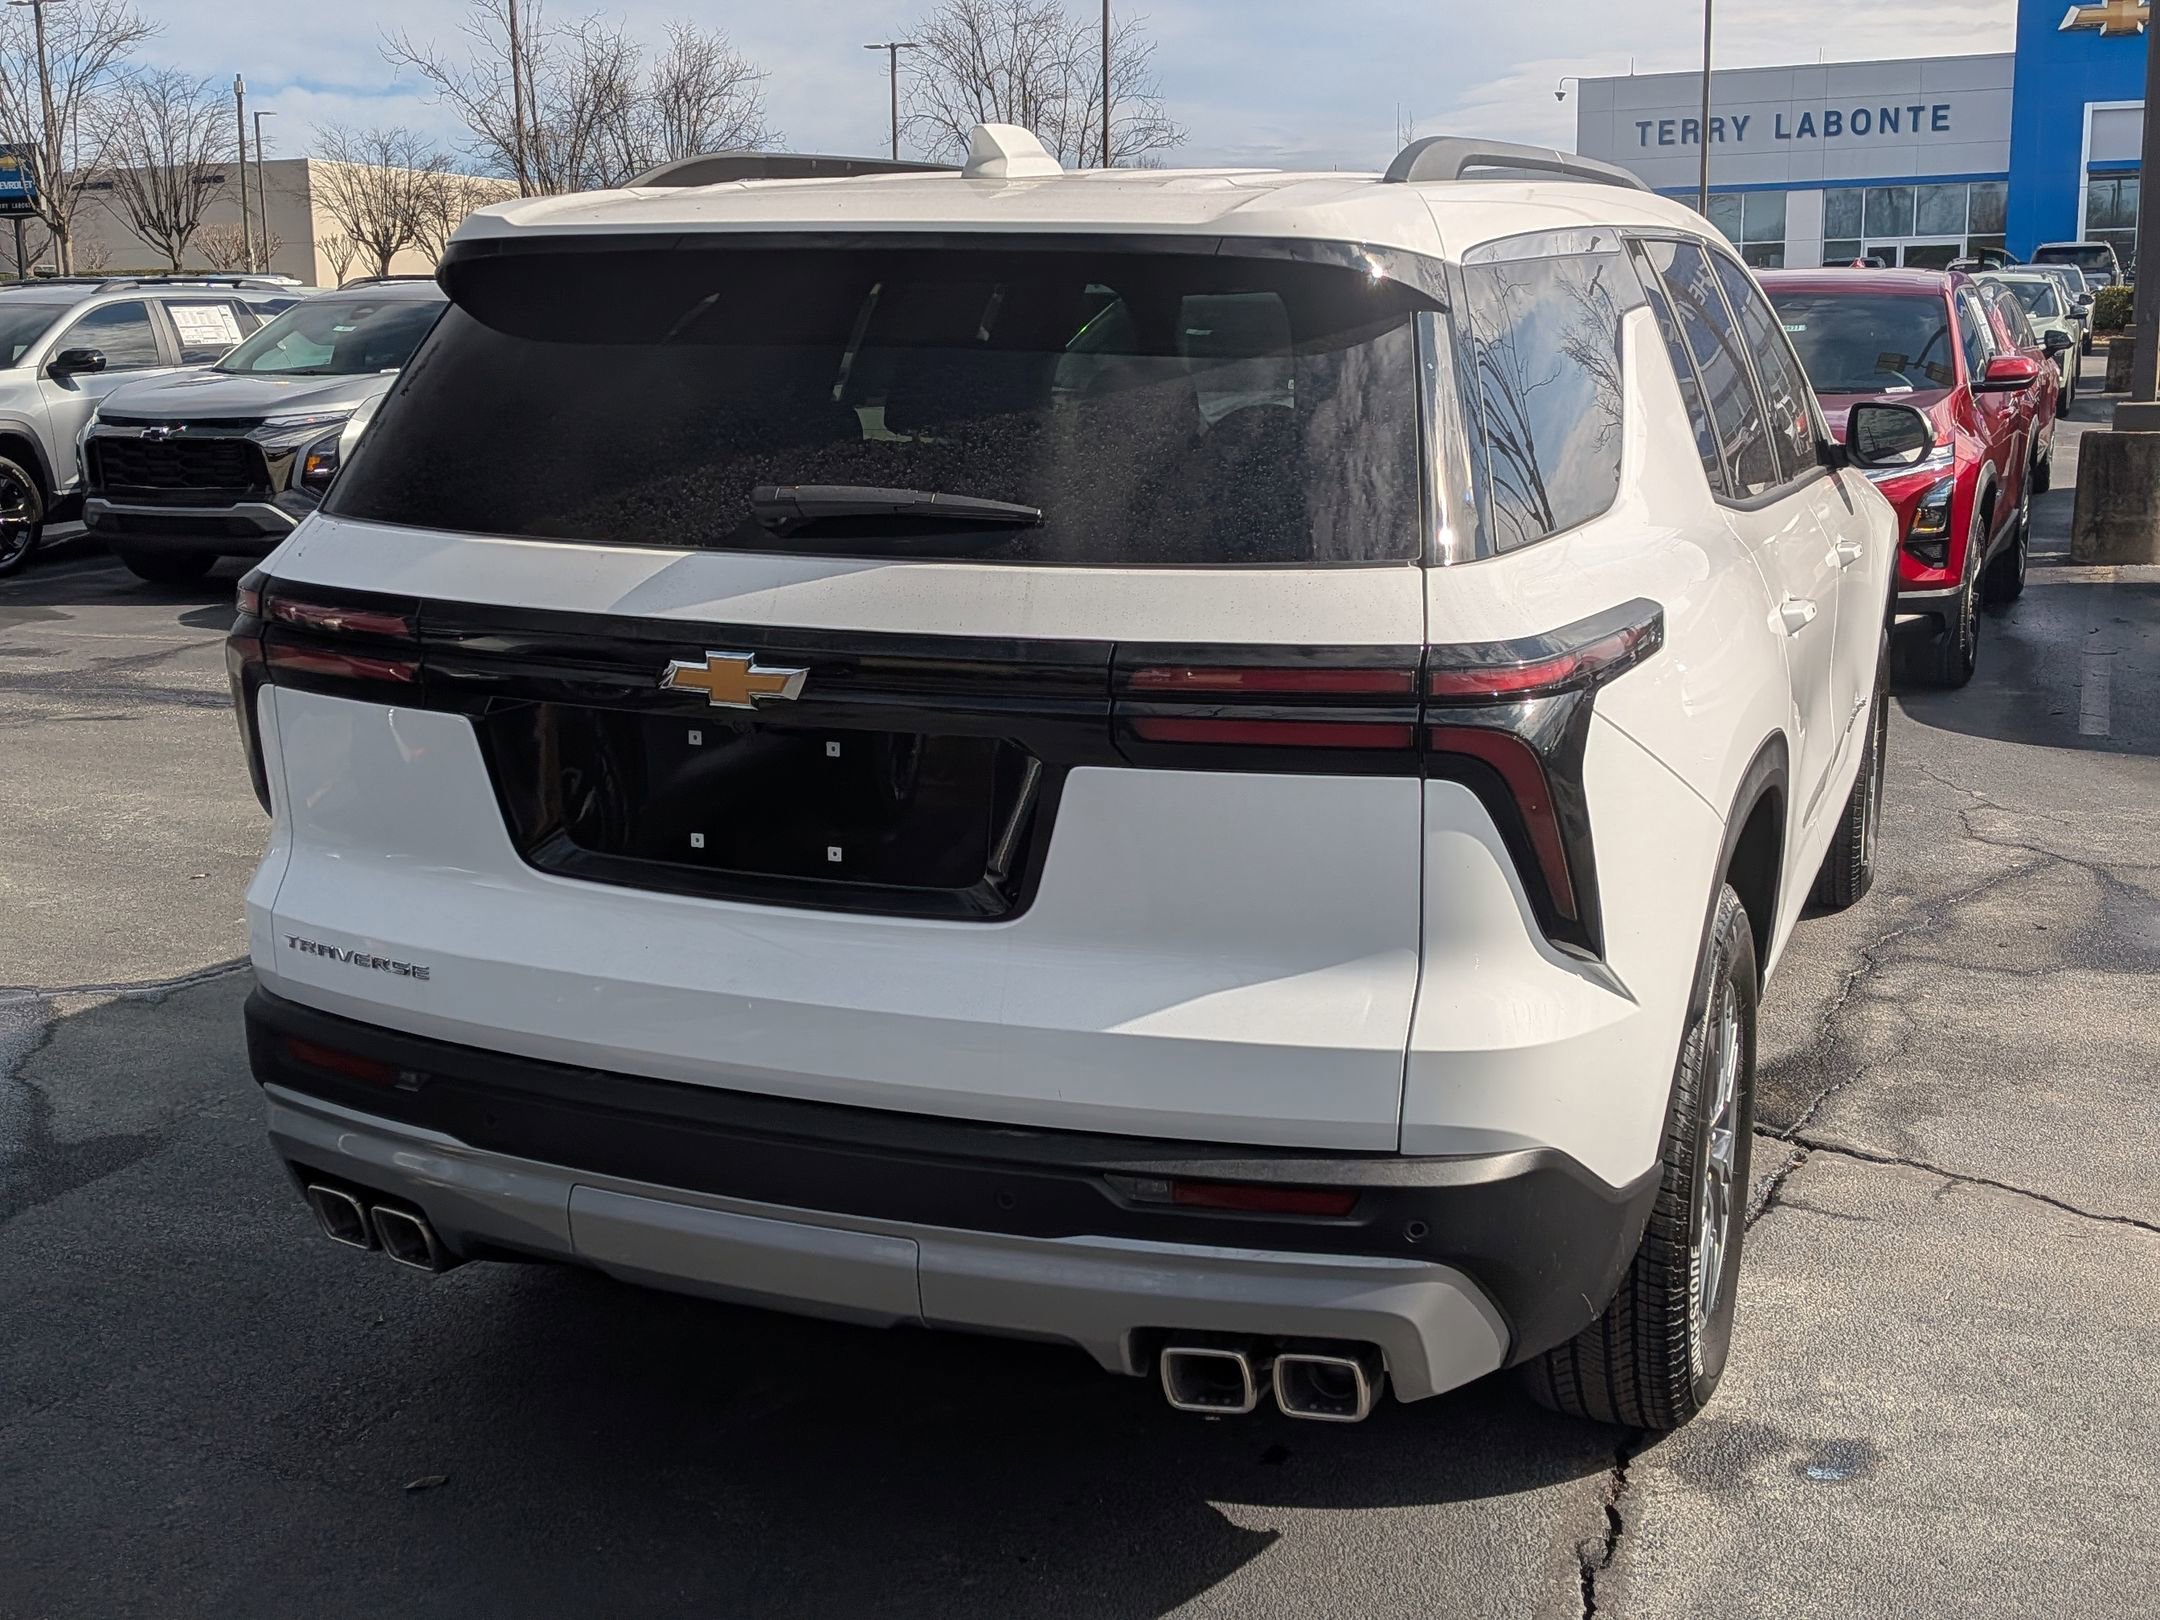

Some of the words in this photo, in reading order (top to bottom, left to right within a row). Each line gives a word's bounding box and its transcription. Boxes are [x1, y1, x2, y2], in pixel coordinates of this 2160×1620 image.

[1635, 115, 1750, 147] TERRY
[1774, 104, 1951, 140] LABONTE
[284, 932, 431, 981] TRAVERSE
